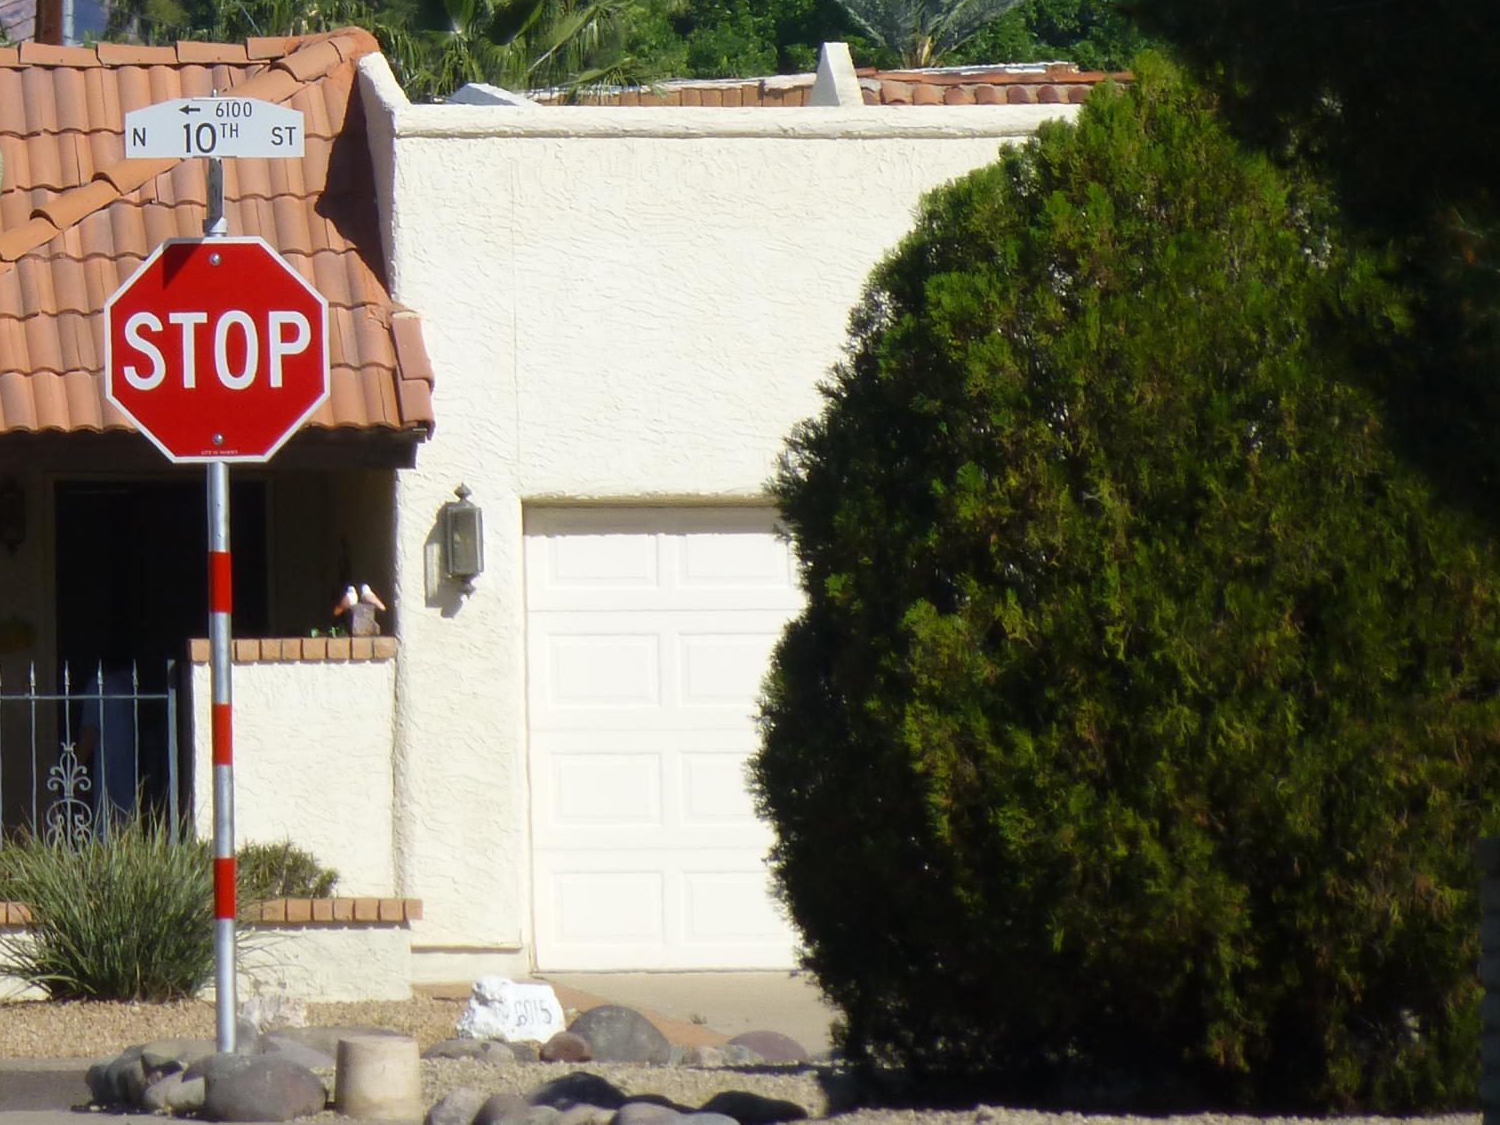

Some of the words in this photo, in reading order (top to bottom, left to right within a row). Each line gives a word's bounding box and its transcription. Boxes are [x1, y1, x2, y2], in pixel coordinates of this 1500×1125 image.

[215, 101, 252, 118] 6100
[132, 127, 146, 147] N
[183, 122, 239, 153] 10TH
[271, 126, 297, 146] ST
[123, 309, 312, 391] STOP
